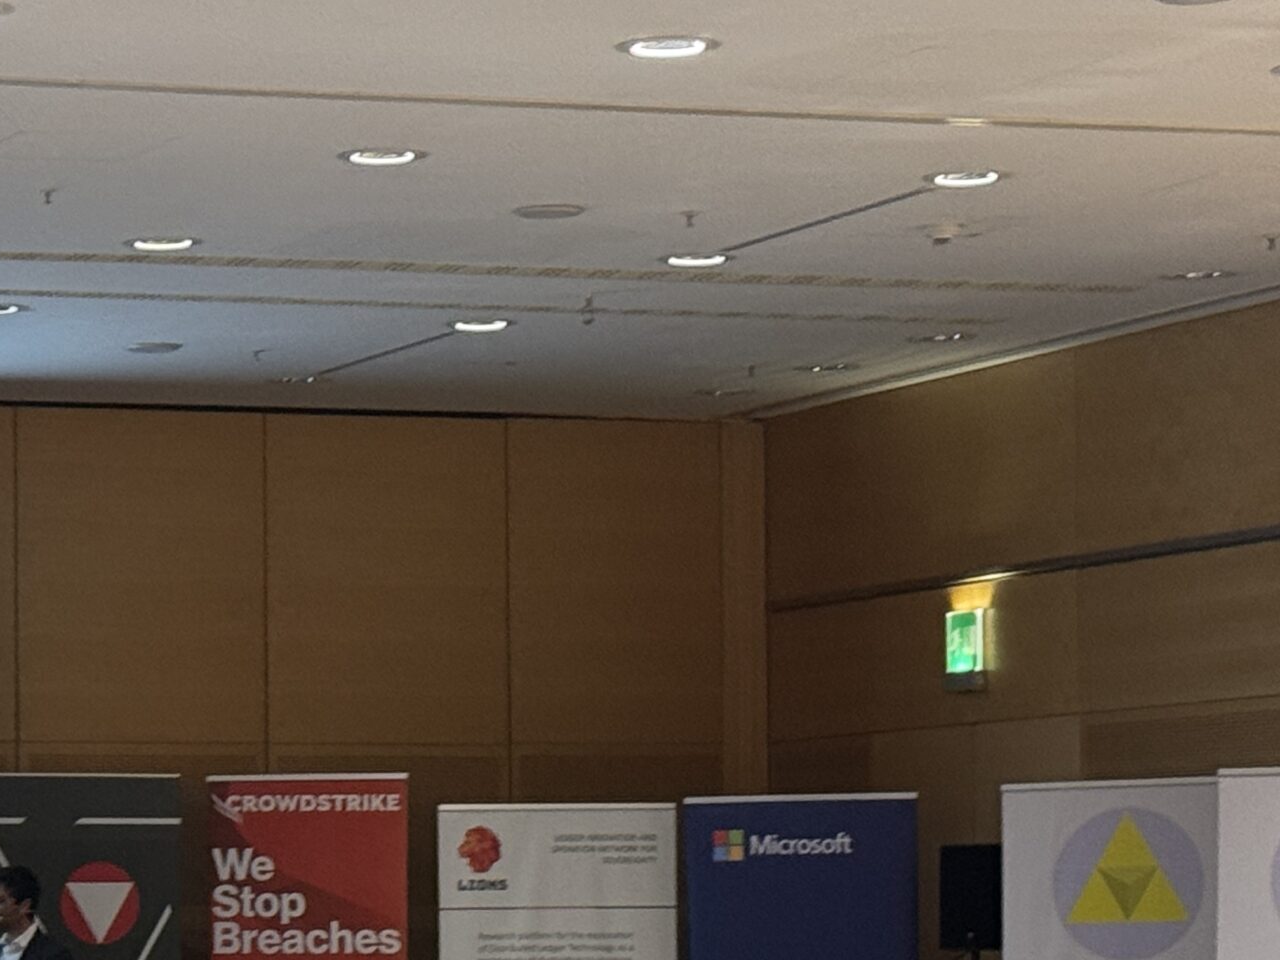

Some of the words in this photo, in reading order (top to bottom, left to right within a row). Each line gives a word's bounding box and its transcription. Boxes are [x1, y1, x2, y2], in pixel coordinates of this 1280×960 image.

[226, 794, 402, 813] CROWDSTRIKE
[749, 831, 853, 855] Microsoft
[211, 848, 276, 881] We
[457, 878, 508, 892] LIONS
[211, 885, 307, 924] Stop
[212, 921, 402, 955] Breaches
